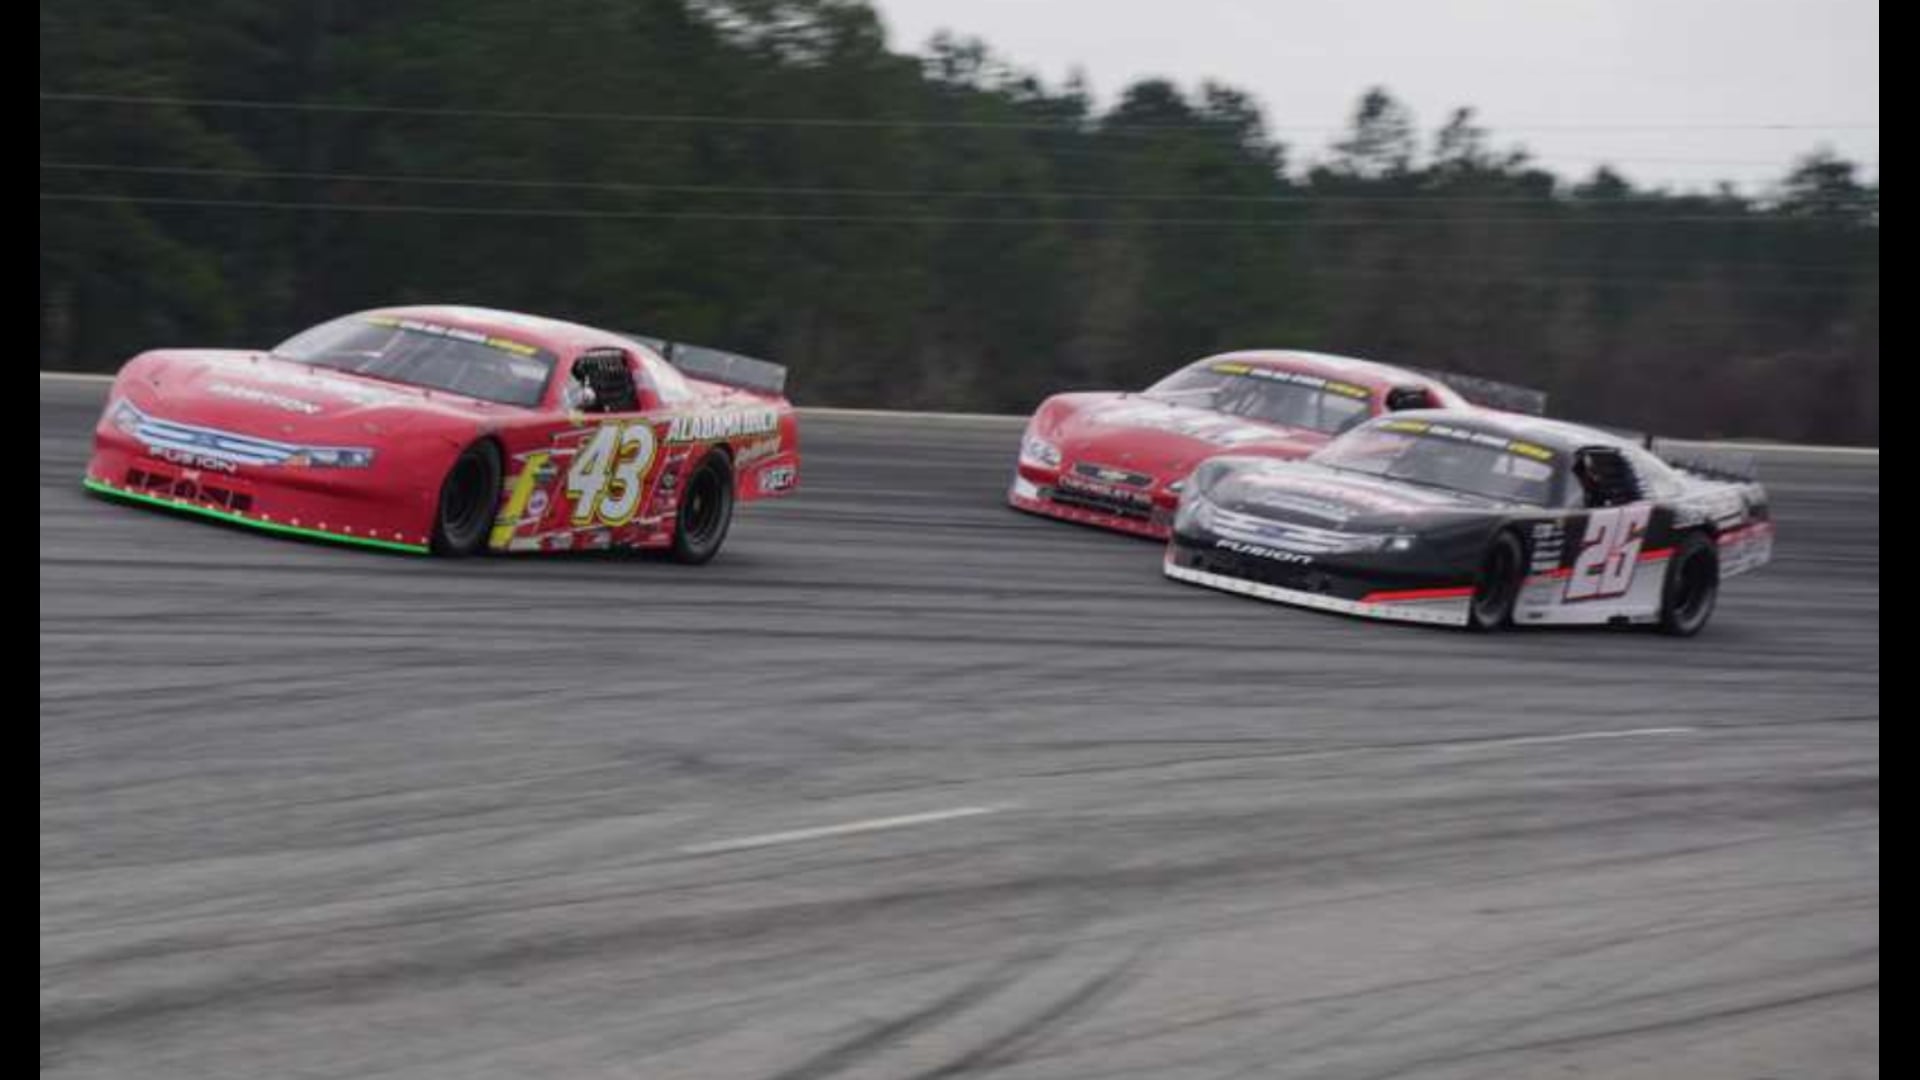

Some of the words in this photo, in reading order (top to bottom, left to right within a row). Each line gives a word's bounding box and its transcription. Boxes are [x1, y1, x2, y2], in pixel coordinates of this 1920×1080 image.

[150, 447, 238, 474] FUSION
[566, 418, 657, 527] 43
[1215, 539, 1315, 565] FUSION
